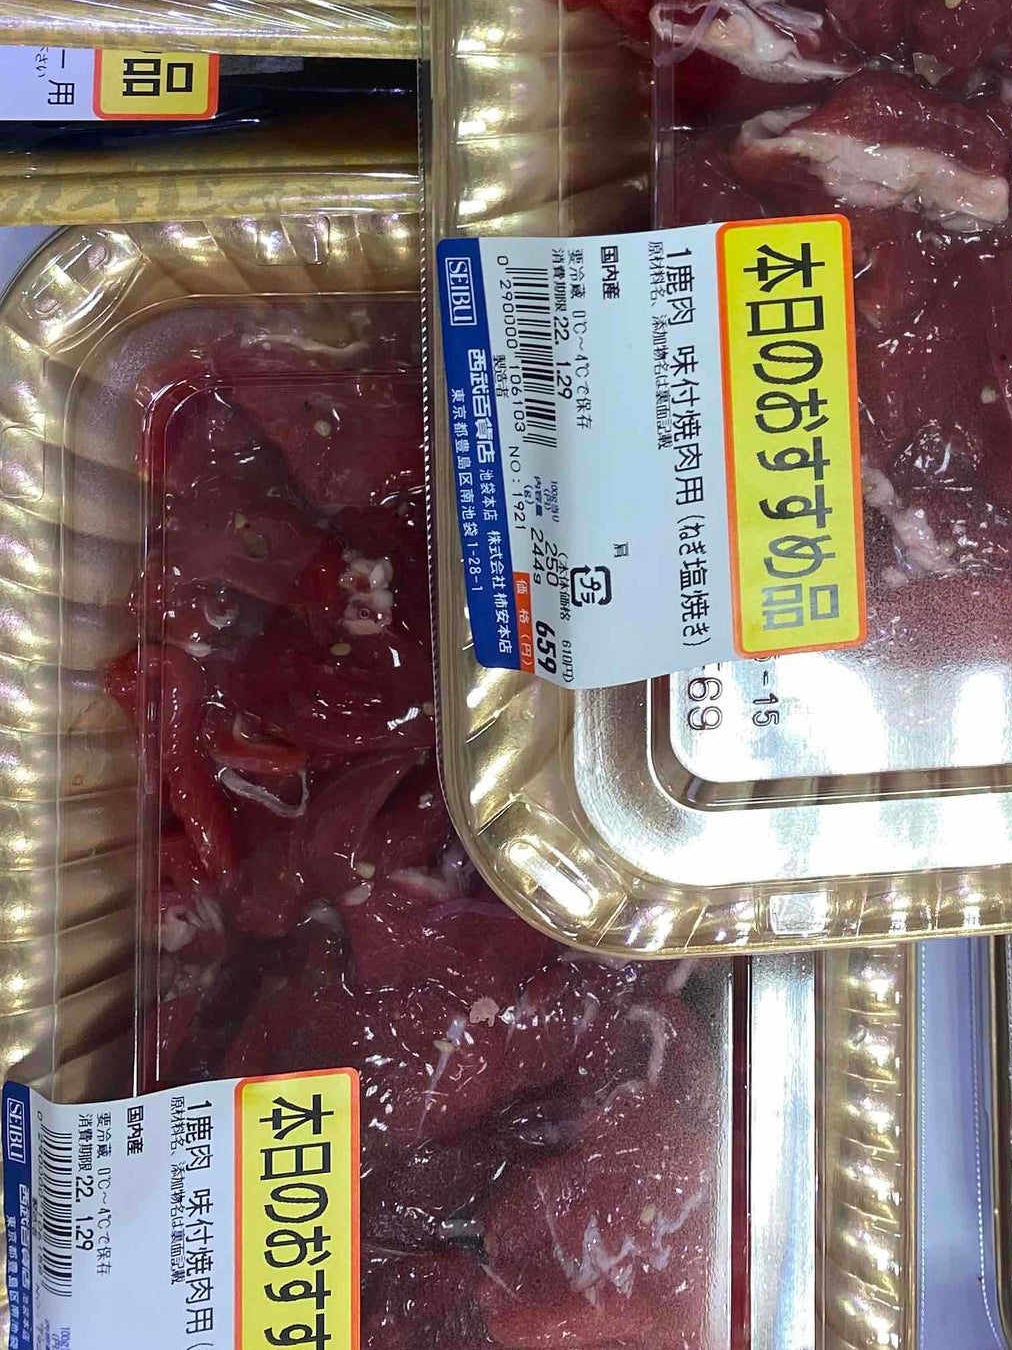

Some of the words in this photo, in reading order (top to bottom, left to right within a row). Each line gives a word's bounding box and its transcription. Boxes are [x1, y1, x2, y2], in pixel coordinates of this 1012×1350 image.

[122, 50, 193, 96] 品
[448, 261, 474, 323] SEIBU
[552, 249, 568, 311] 消費期限
[568, 250, 586, 299] 要冷蔵
[600, 246, 620, 300] 国内産
[666, 247, 693, 326] 1鹿肉
[500, 279, 518, 349] 290000
[509, 365, 526, 432] 106103
[648, 241, 673, 450] 原材料名、添加物名は裏面記載
[493, 354, 509, 398] 製造者
[467, 349, 498, 464] 西武百貨店
[743, 243, 840, 630] 本日のおすすめ品
[451, 388, 479, 537] 東京都豊島区南池袋
[466, 542, 484, 592] 1-28-1
[479, 469, 499, 521] 池袋本店
[487, 530, 505, 589] 株式会社
[530, 527, 545, 586] 244g
[544, 543, 559, 588] 250
[493, 593, 513, 654] 柿安本店
[536, 620, 557, 674] 659
[8, 1102, 24, 1162] SEIBU
[78, 1113, 94, 1171] 消費期限
[97, 1112, 111, 1158] 要冷蔵
[127, 1105, 144, 1156] 国内産
[185, 1100, 214, 1171] 1鹿肉
[170, 1096, 185, 1285] 原材料名、添加物名は裏面記載
